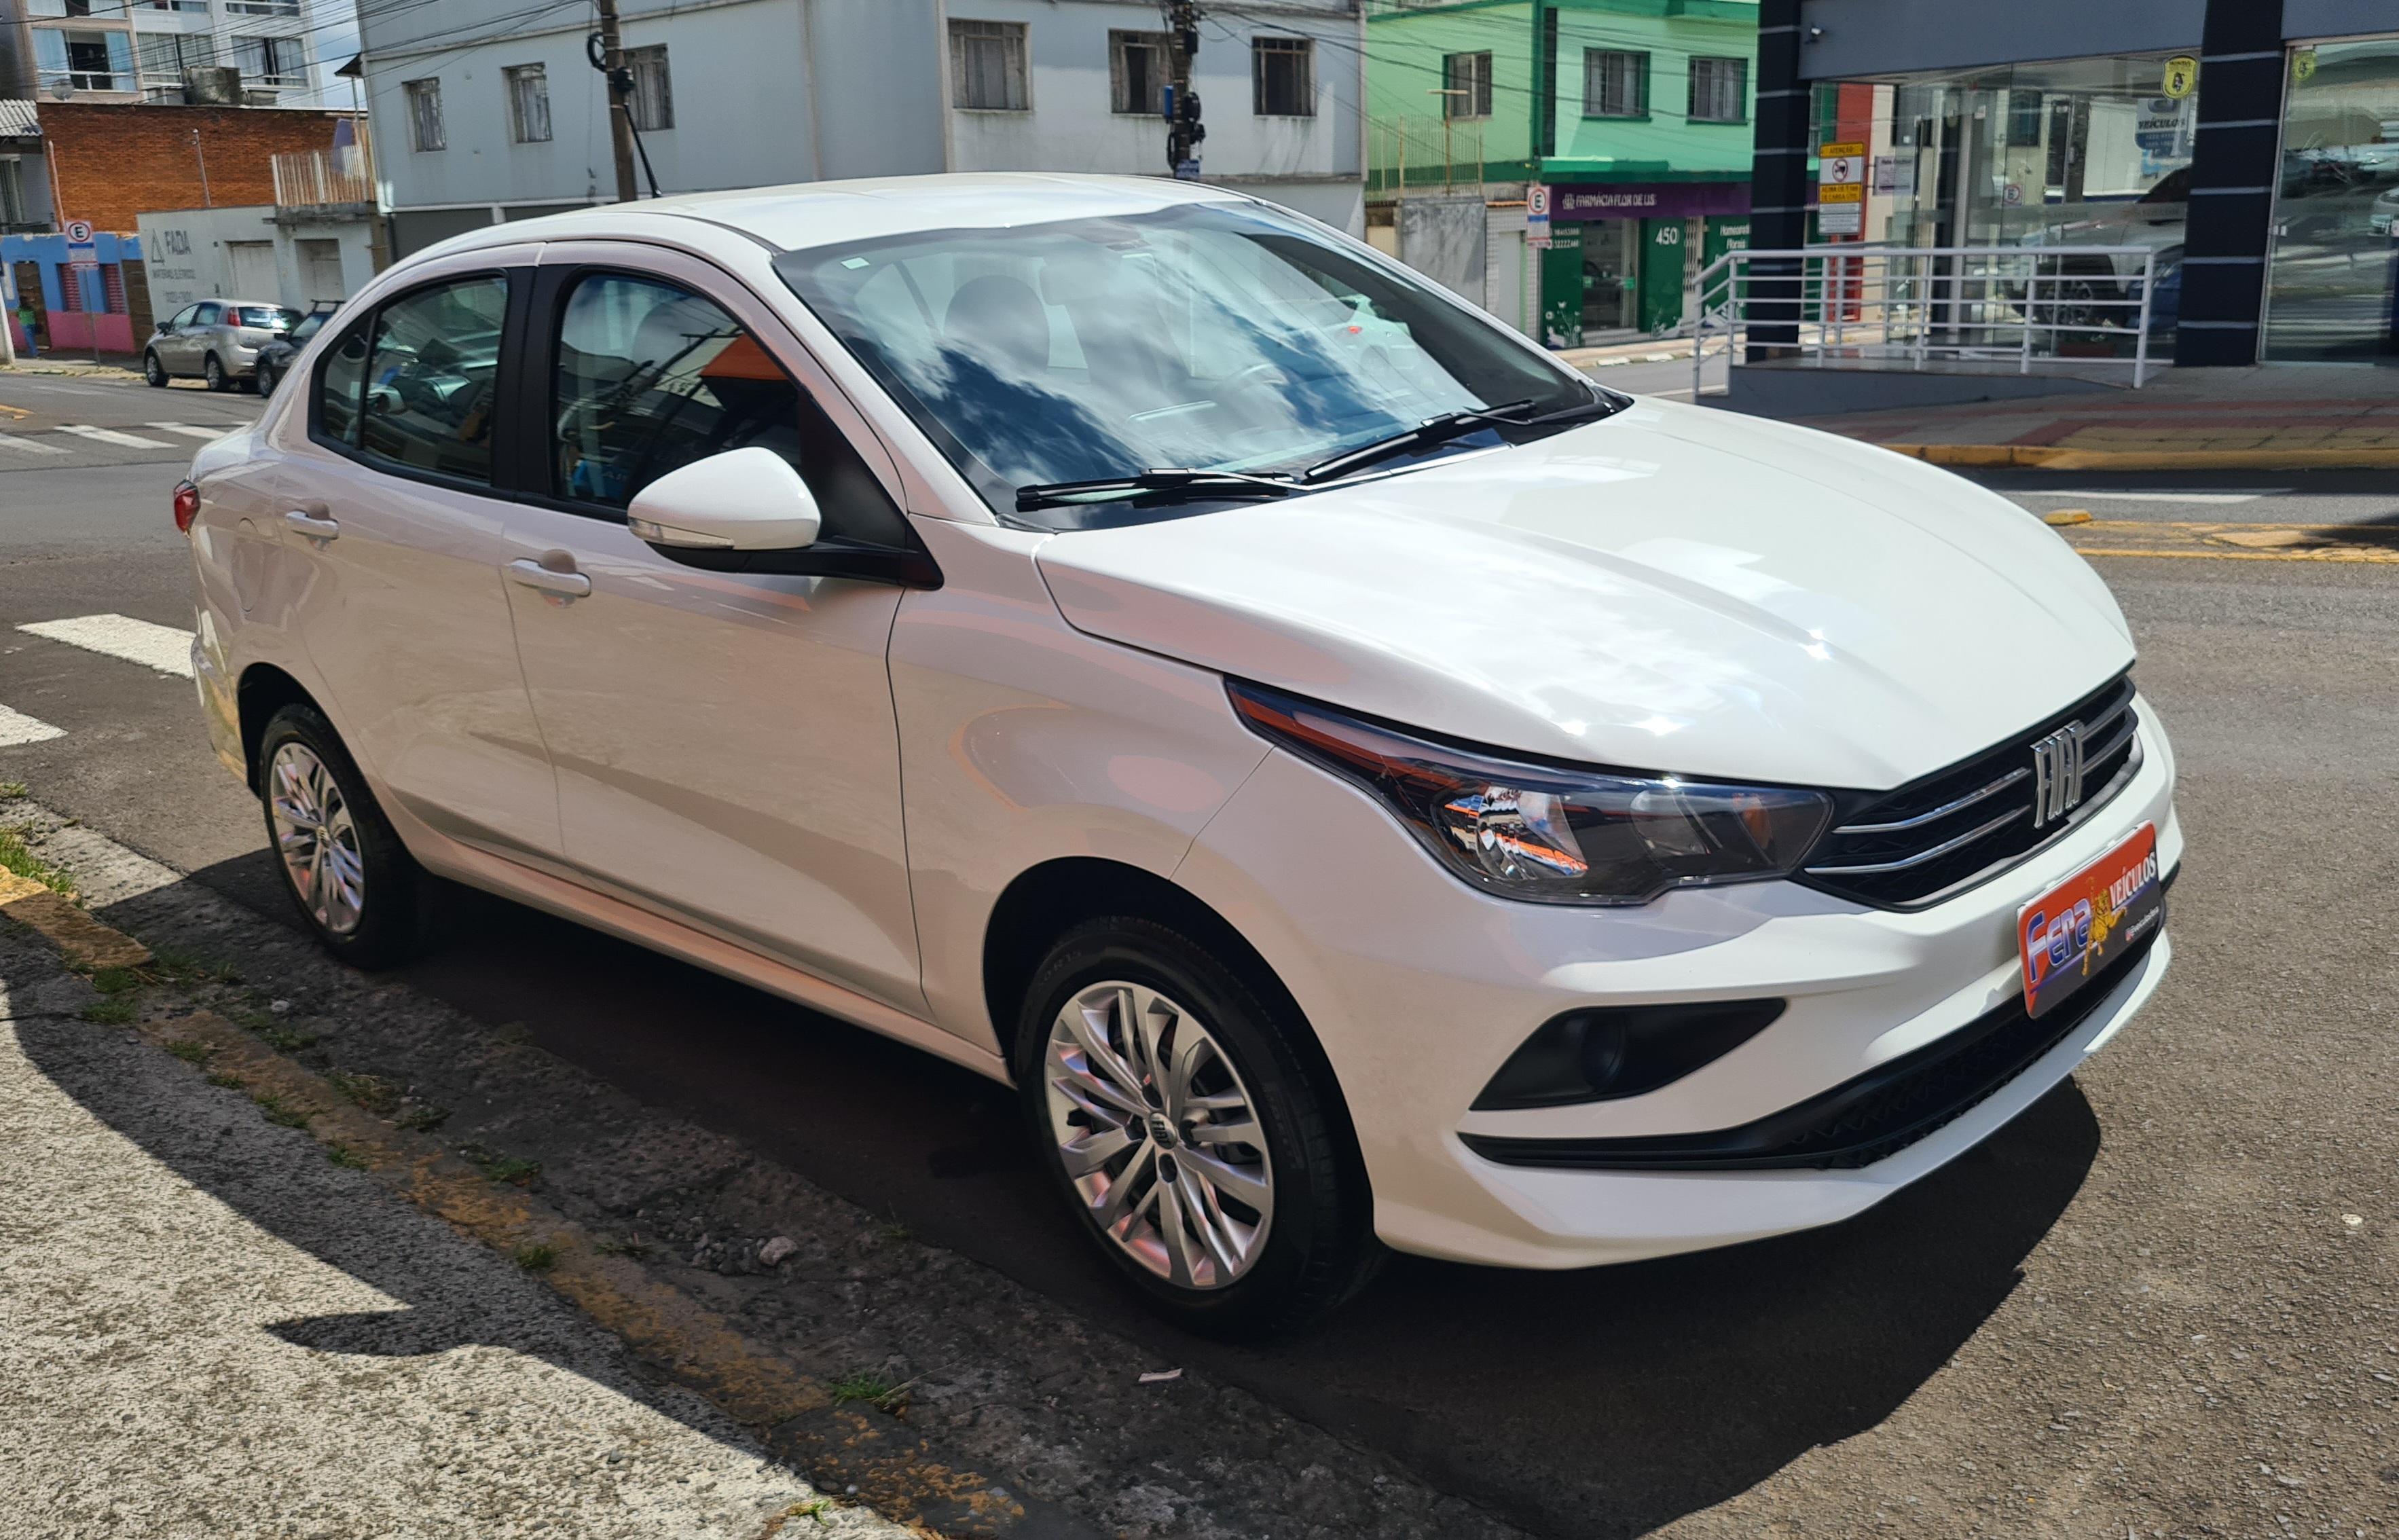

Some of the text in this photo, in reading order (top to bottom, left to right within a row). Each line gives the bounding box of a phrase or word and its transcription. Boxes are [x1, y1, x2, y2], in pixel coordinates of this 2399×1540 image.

[1535, 194, 1541, 208] E
[1576, 191, 1656, 206] FARMÁCIA FLOR DE LIS
[75, 226, 84, 238] E
[1655, 227, 1679, 244] 450
[2030, 719, 2084, 830] FIAT
[2026, 851, 2156, 983] Fera VEÍCULOS
[1151, 1120, 1171, 1145] FIAT
